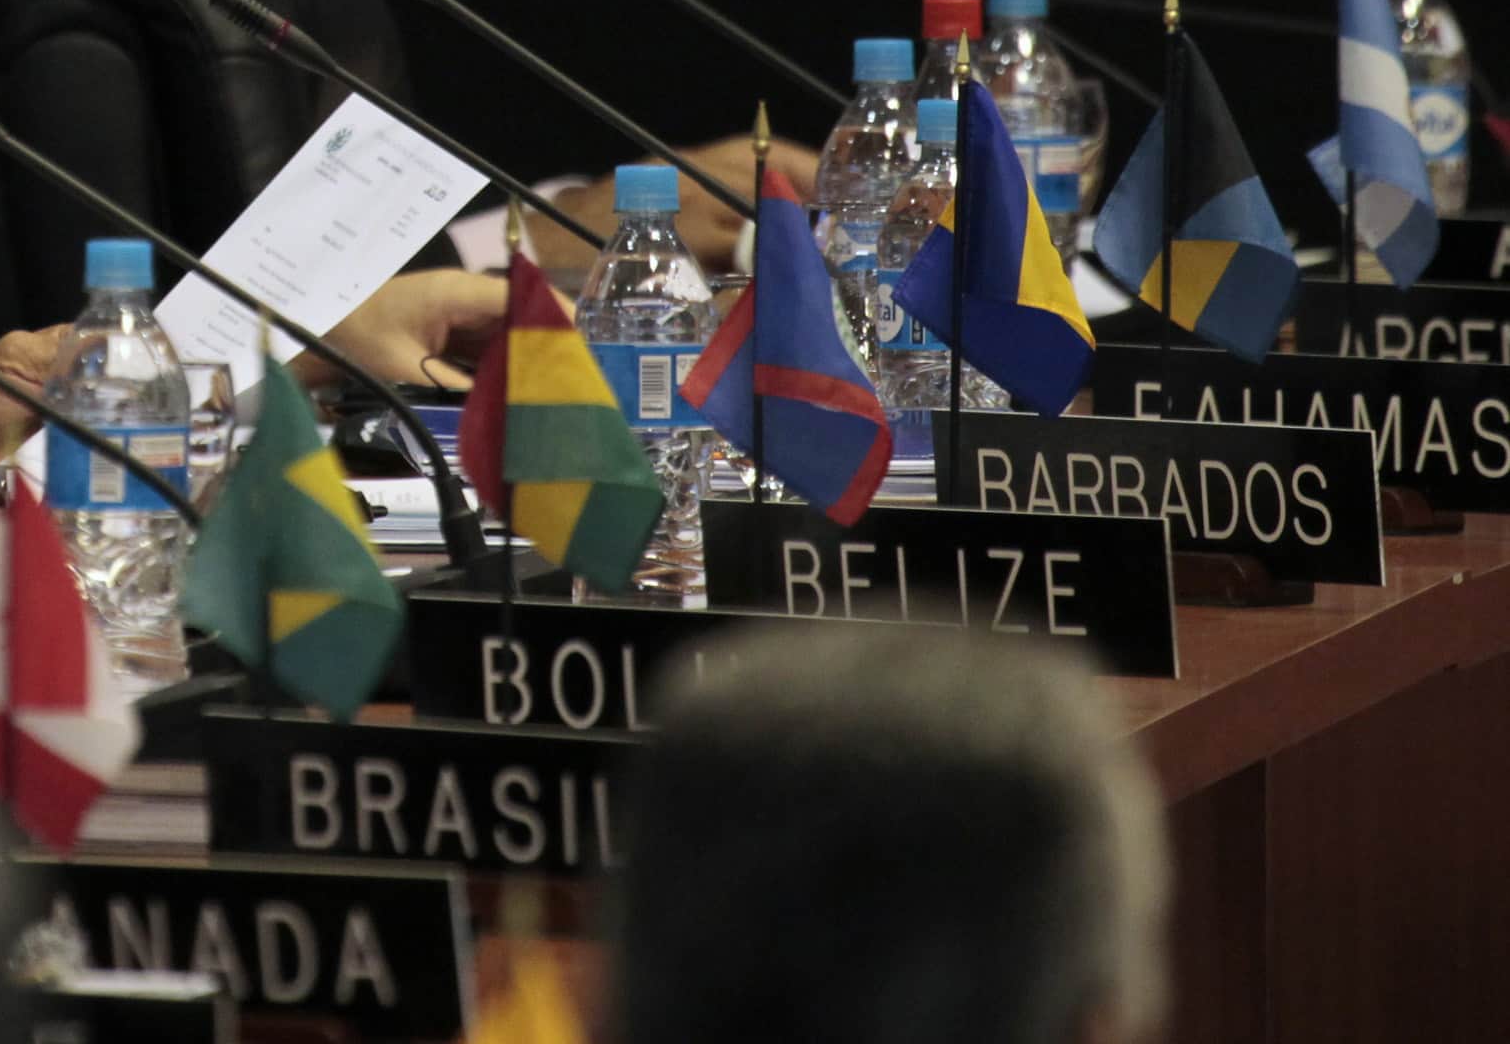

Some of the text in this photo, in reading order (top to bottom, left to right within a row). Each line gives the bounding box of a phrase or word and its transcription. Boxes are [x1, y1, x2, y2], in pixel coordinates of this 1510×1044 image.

[976, 447, 1334, 546] BARBADOS
[782, 539, 1088, 637] BELIZE
[288, 752, 628, 870] BRASIL
